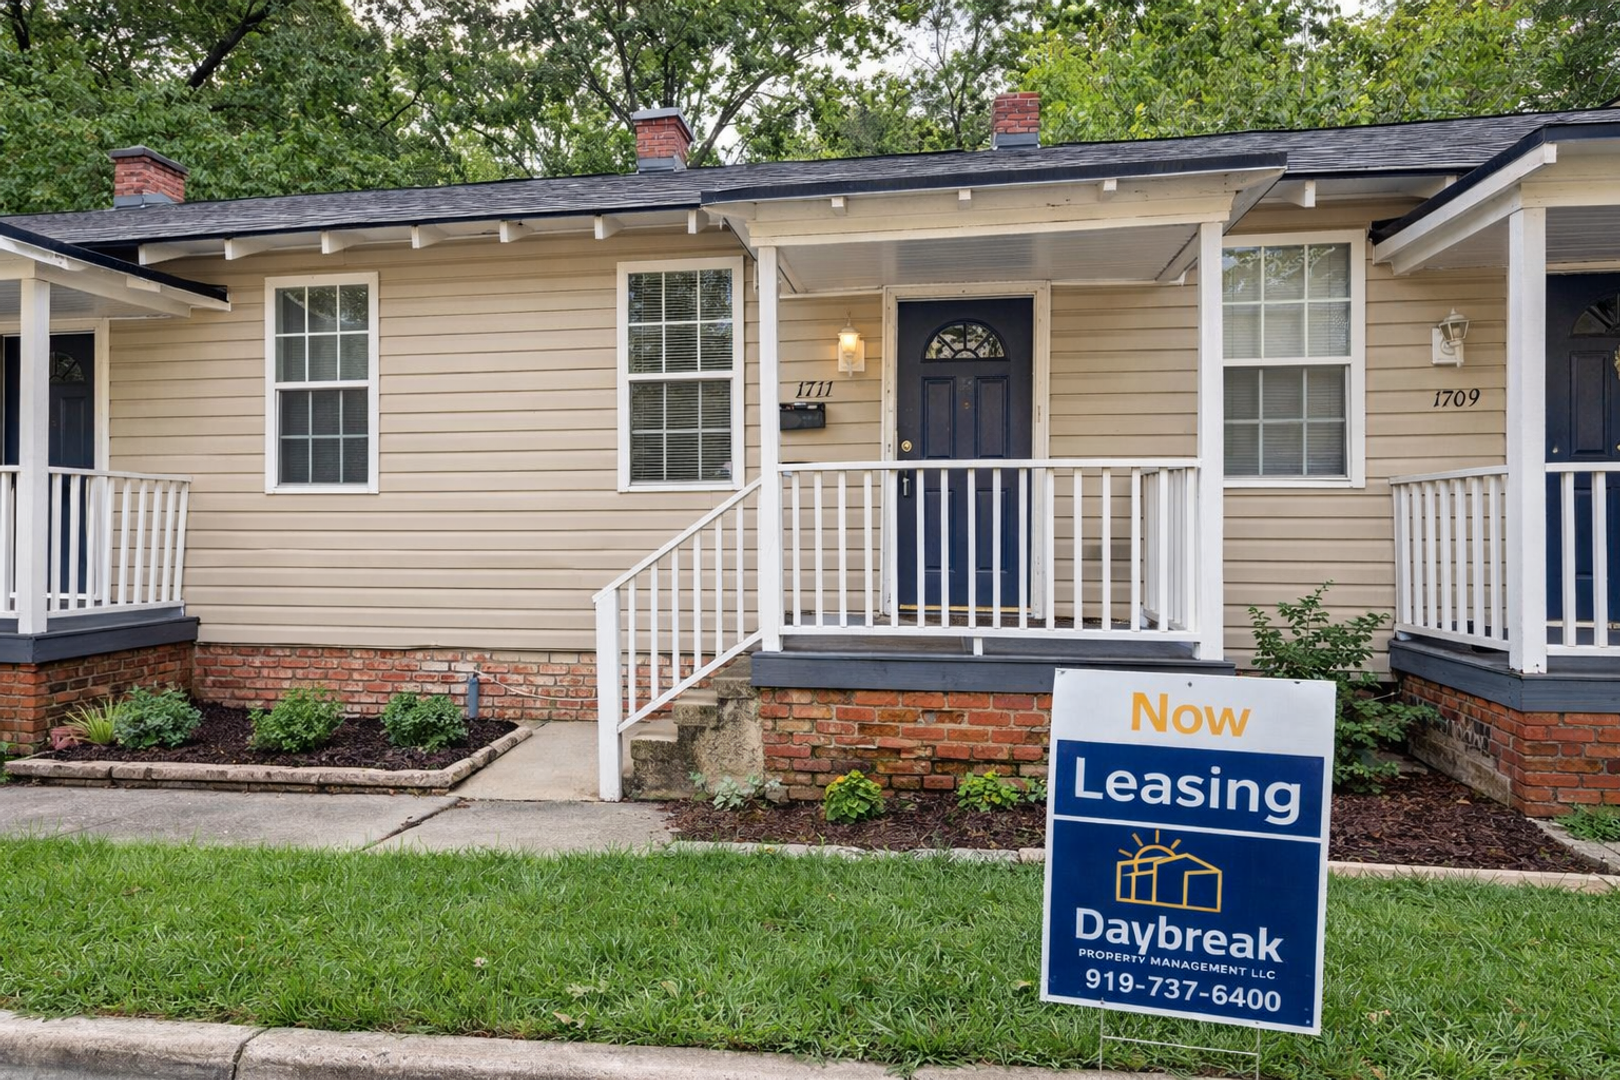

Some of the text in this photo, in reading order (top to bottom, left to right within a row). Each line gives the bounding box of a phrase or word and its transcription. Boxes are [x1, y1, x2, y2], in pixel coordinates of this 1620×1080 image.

[796, 381, 833, 398] 1711
[1433, 388, 1481, 408] 1709
[1131, 692, 1251, 737] Now
[1074, 757, 1301, 825] Leasing
[1075, 907, 1284, 963] Daybreak
[1078, 948, 1276, 980] PROPERTY MANAGEMENT LLC
[1085, 968, 1282, 1013] 919-737-6400
